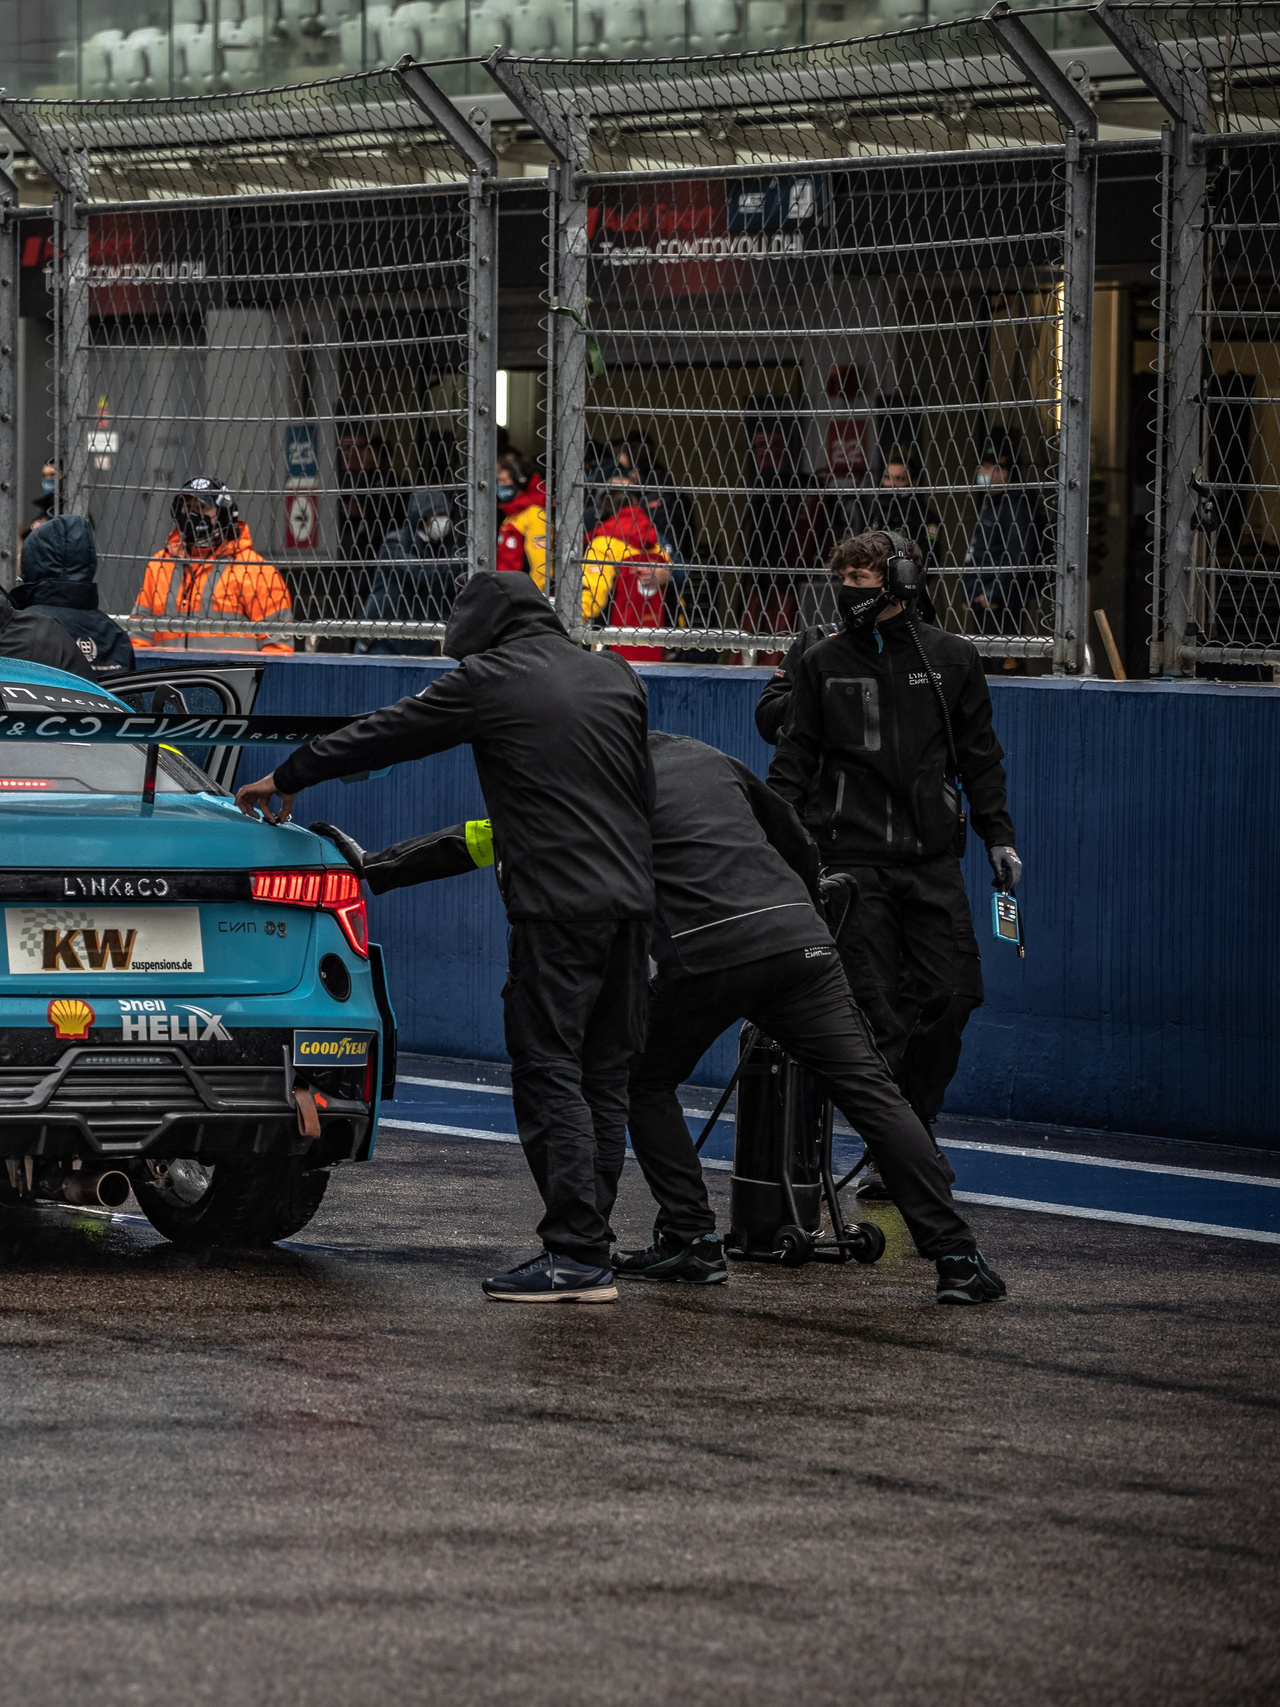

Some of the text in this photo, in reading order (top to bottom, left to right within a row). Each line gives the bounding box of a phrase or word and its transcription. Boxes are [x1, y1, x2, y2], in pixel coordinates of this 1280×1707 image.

[116, 718, 249, 739] CYAN
[250, 731, 327, 742] RACIN
[64, 877, 169, 896] LYNK&CO
[218, 920, 288, 937] CYAN 03
[42, 928, 138, 971] KW
[131, 959, 193, 973] suspensions.de
[119, 1000, 166, 1012] Shell
[120, 1013, 234, 1041] HELIX
